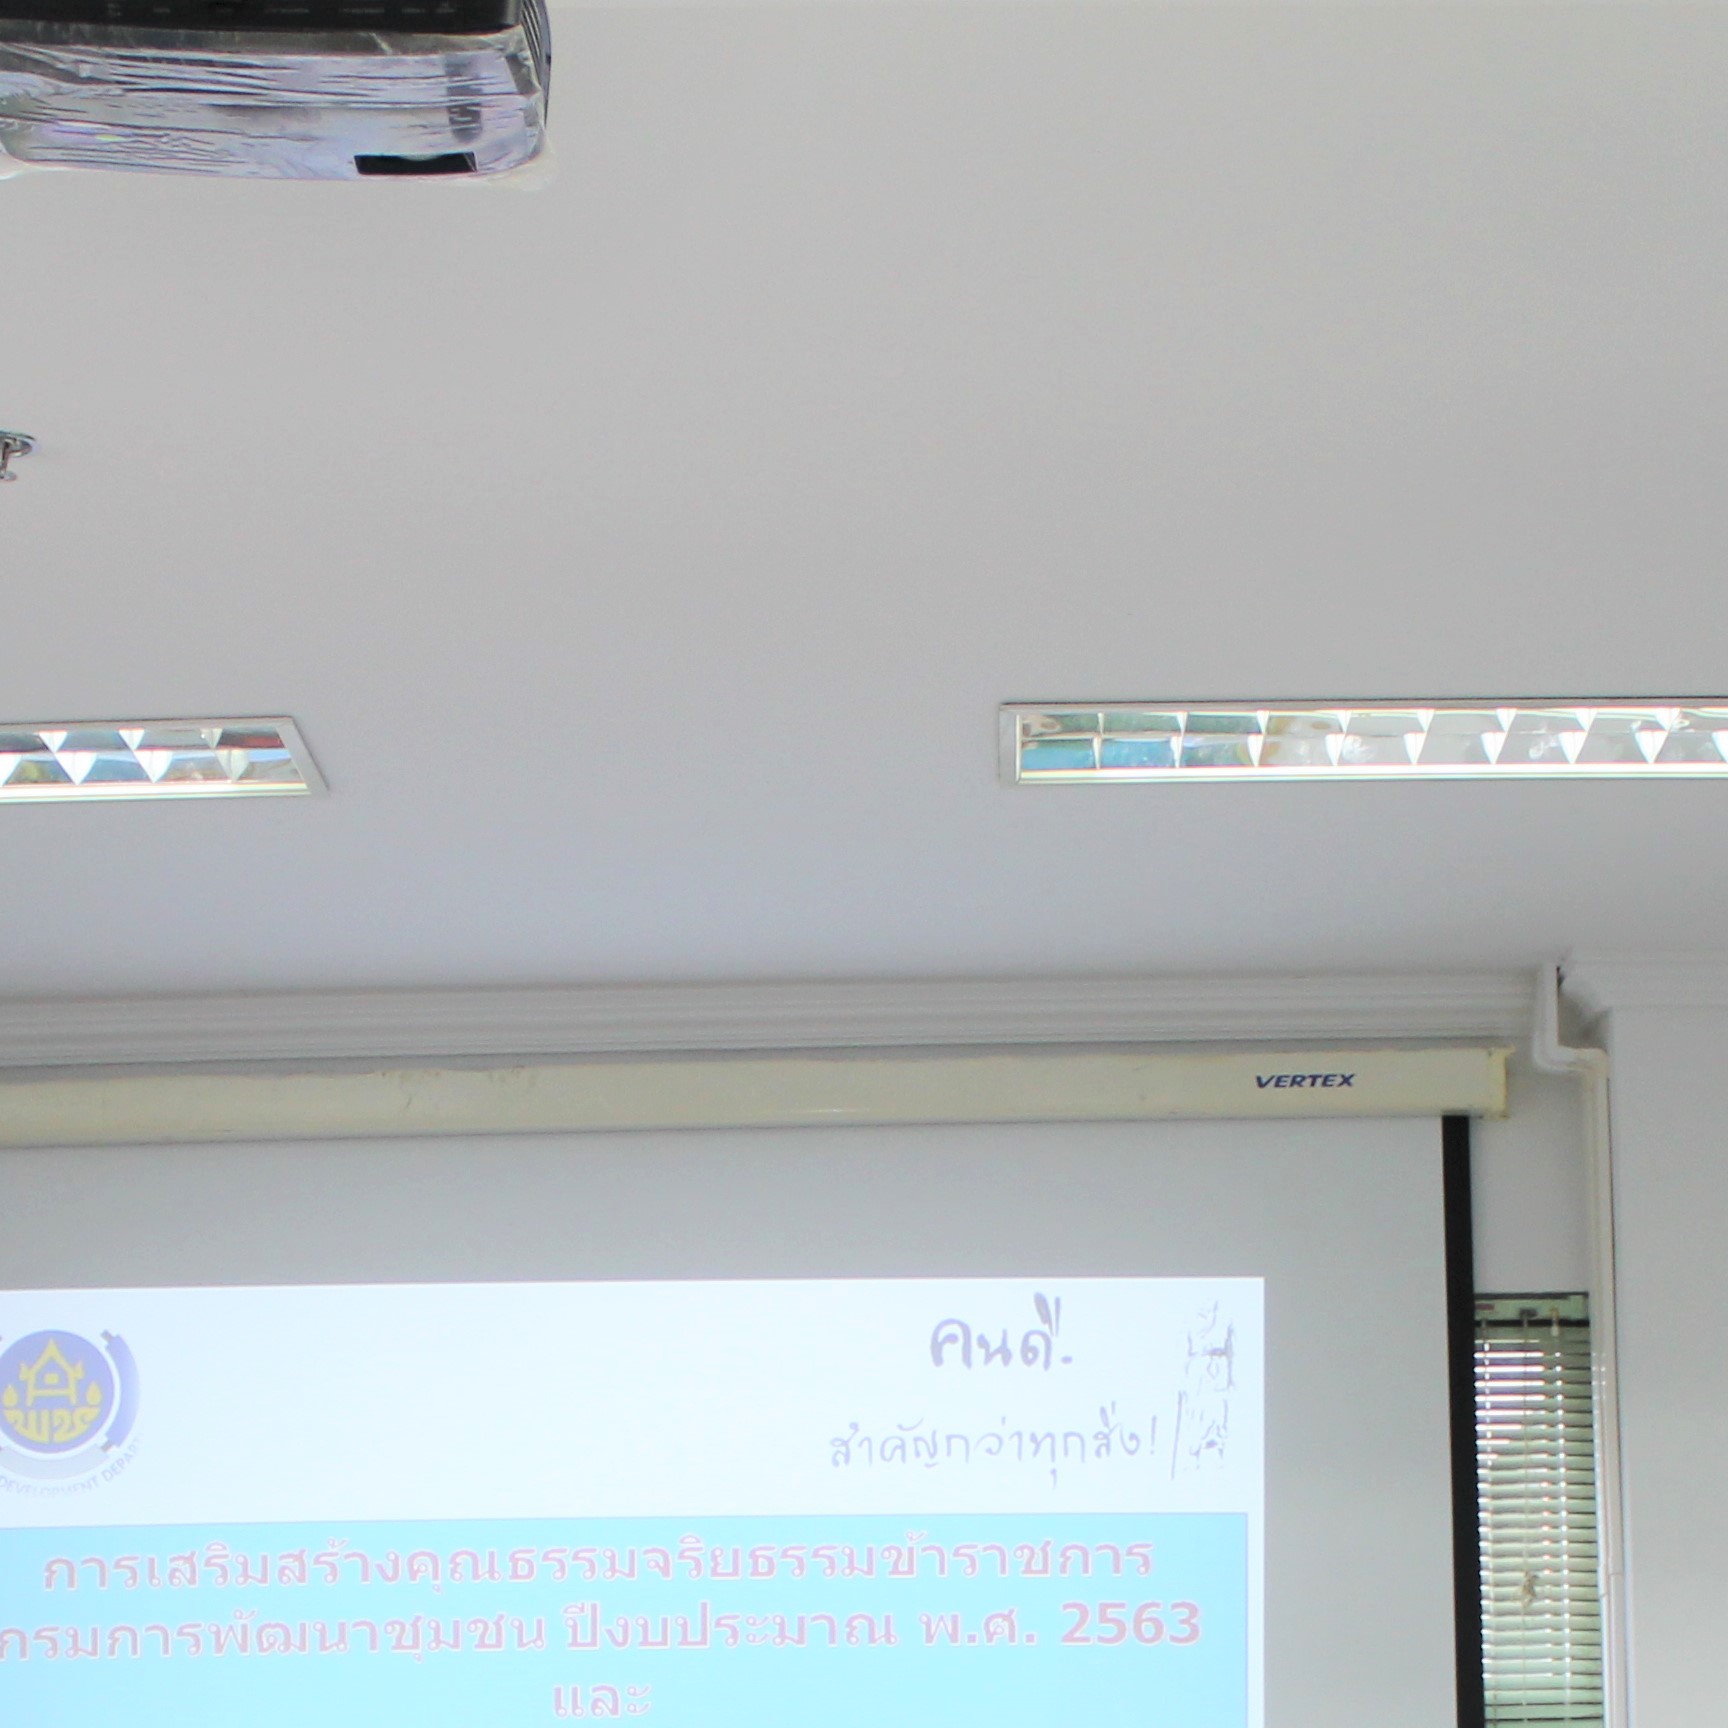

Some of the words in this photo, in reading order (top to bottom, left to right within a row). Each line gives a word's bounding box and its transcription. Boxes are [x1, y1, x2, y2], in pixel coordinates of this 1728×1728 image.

[1255, 1073, 1356, 1089] VERTEX
[42, 1530, 1155, 1593] การเสริมสร้างคุณธรรมจริยธรรมข้าราชการ
[564, 1599, 901, 1652] ปีงบประมาณ
[920, 1606, 1040, 1648] พ.ศ.
[1060, 1600, 1203, 1647] 2563
[552, 1681, 653, 1722] และ
